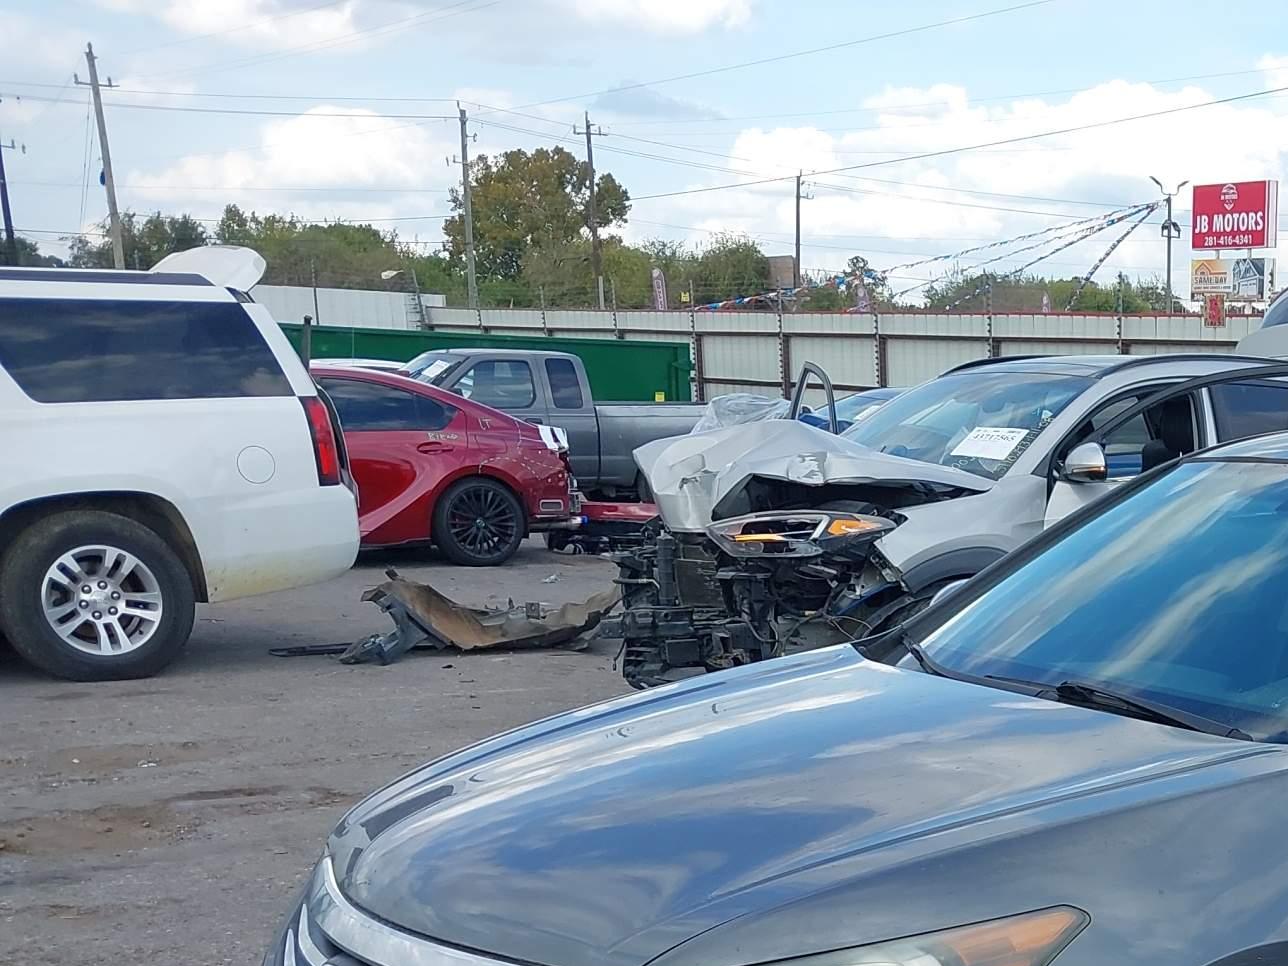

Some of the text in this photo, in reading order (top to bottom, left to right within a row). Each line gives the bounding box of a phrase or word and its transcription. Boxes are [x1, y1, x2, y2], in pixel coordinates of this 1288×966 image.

[1195, 211, 1264, 234] JB MOTORS
[1204, 234, 1252, 246] 281-416-4341
